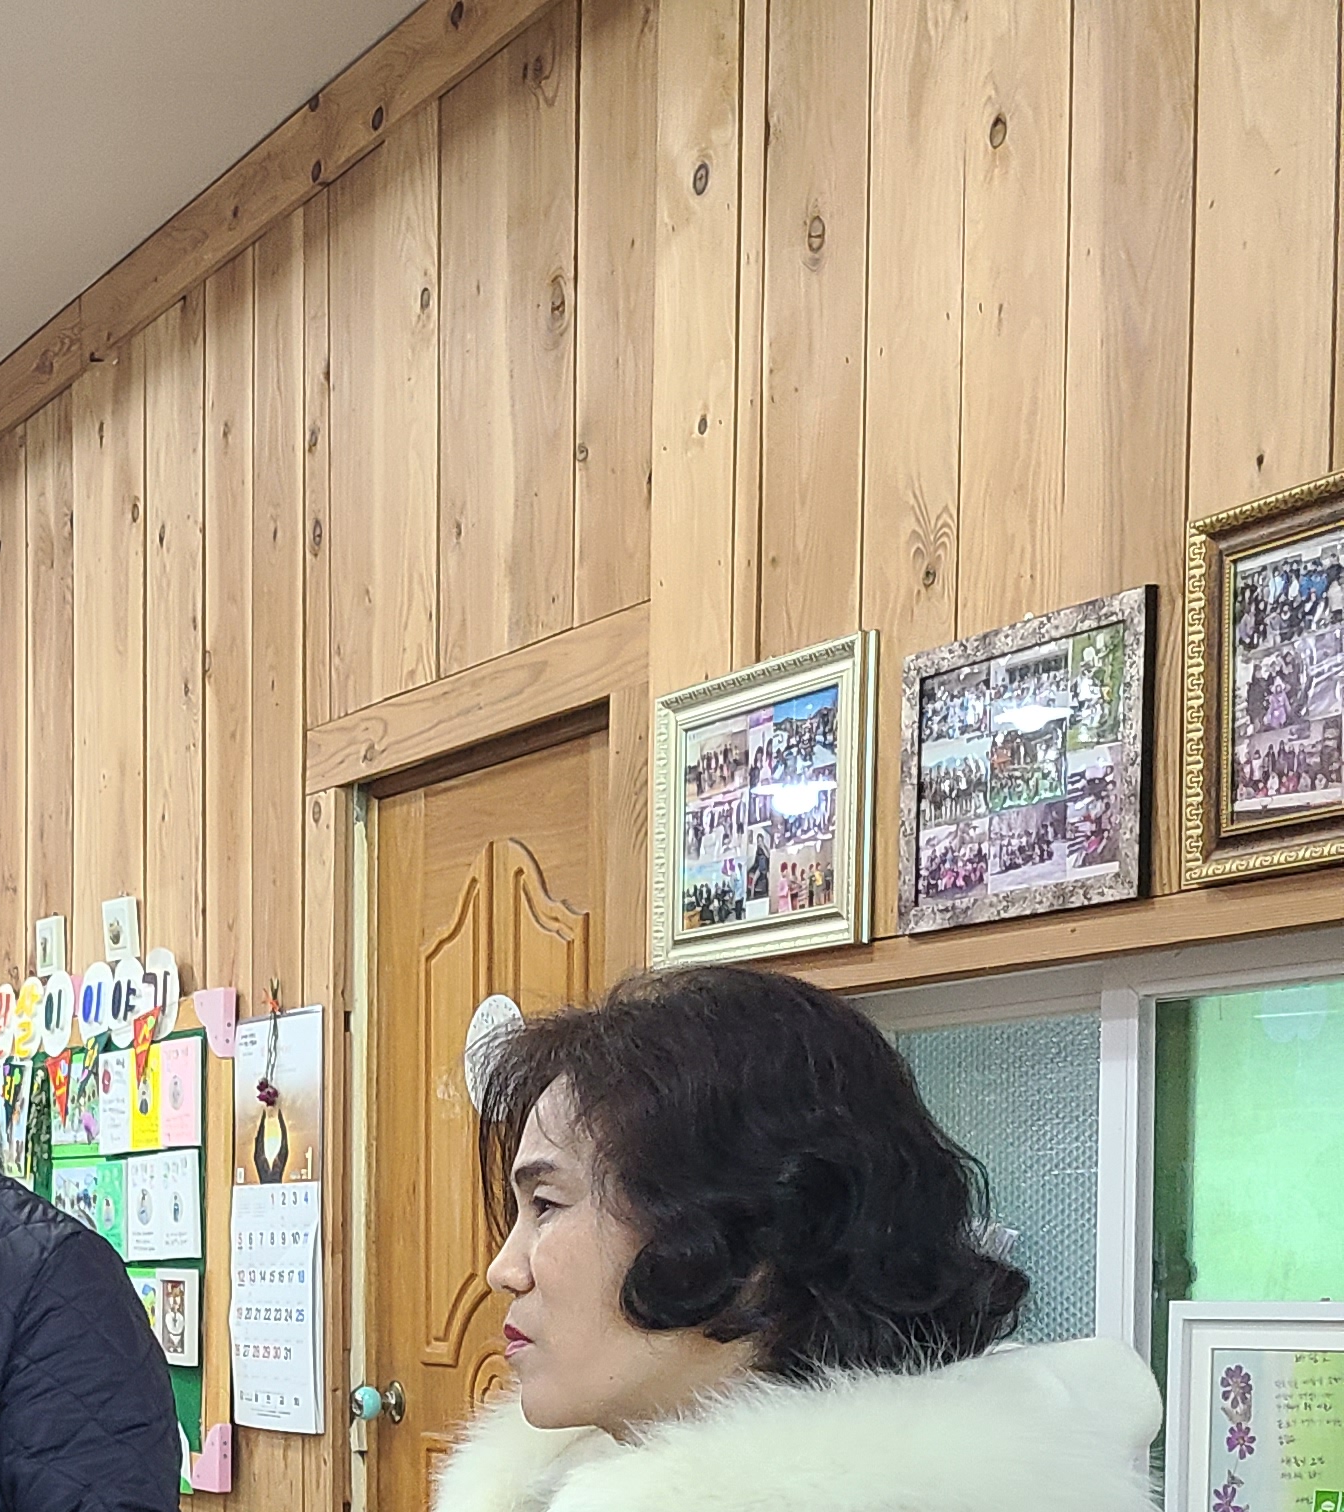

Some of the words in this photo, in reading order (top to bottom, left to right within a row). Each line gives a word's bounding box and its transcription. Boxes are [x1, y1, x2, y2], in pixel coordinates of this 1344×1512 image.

[82, 970, 170, 1023] 이야기
[281, 1191, 286, 1206] 2
[292, 1191, 298, 1206] 3
[248, 1232, 253, 1246] 6
[270, 1231, 275, 1245] 8
[281, 1231, 286, 1245] 9
[291, 1231, 300, 1245] 10
[244, 1307, 252, 1320] 20
[253, 1307, 261, 1321] 21
[263, 1307, 272, 1321] 22
[273, 1307, 282, 1321] 23
[284, 1308, 293, 1322] 24
[295, 1308, 305, 1322] 25
[283, 1346, 292, 1360] 31
